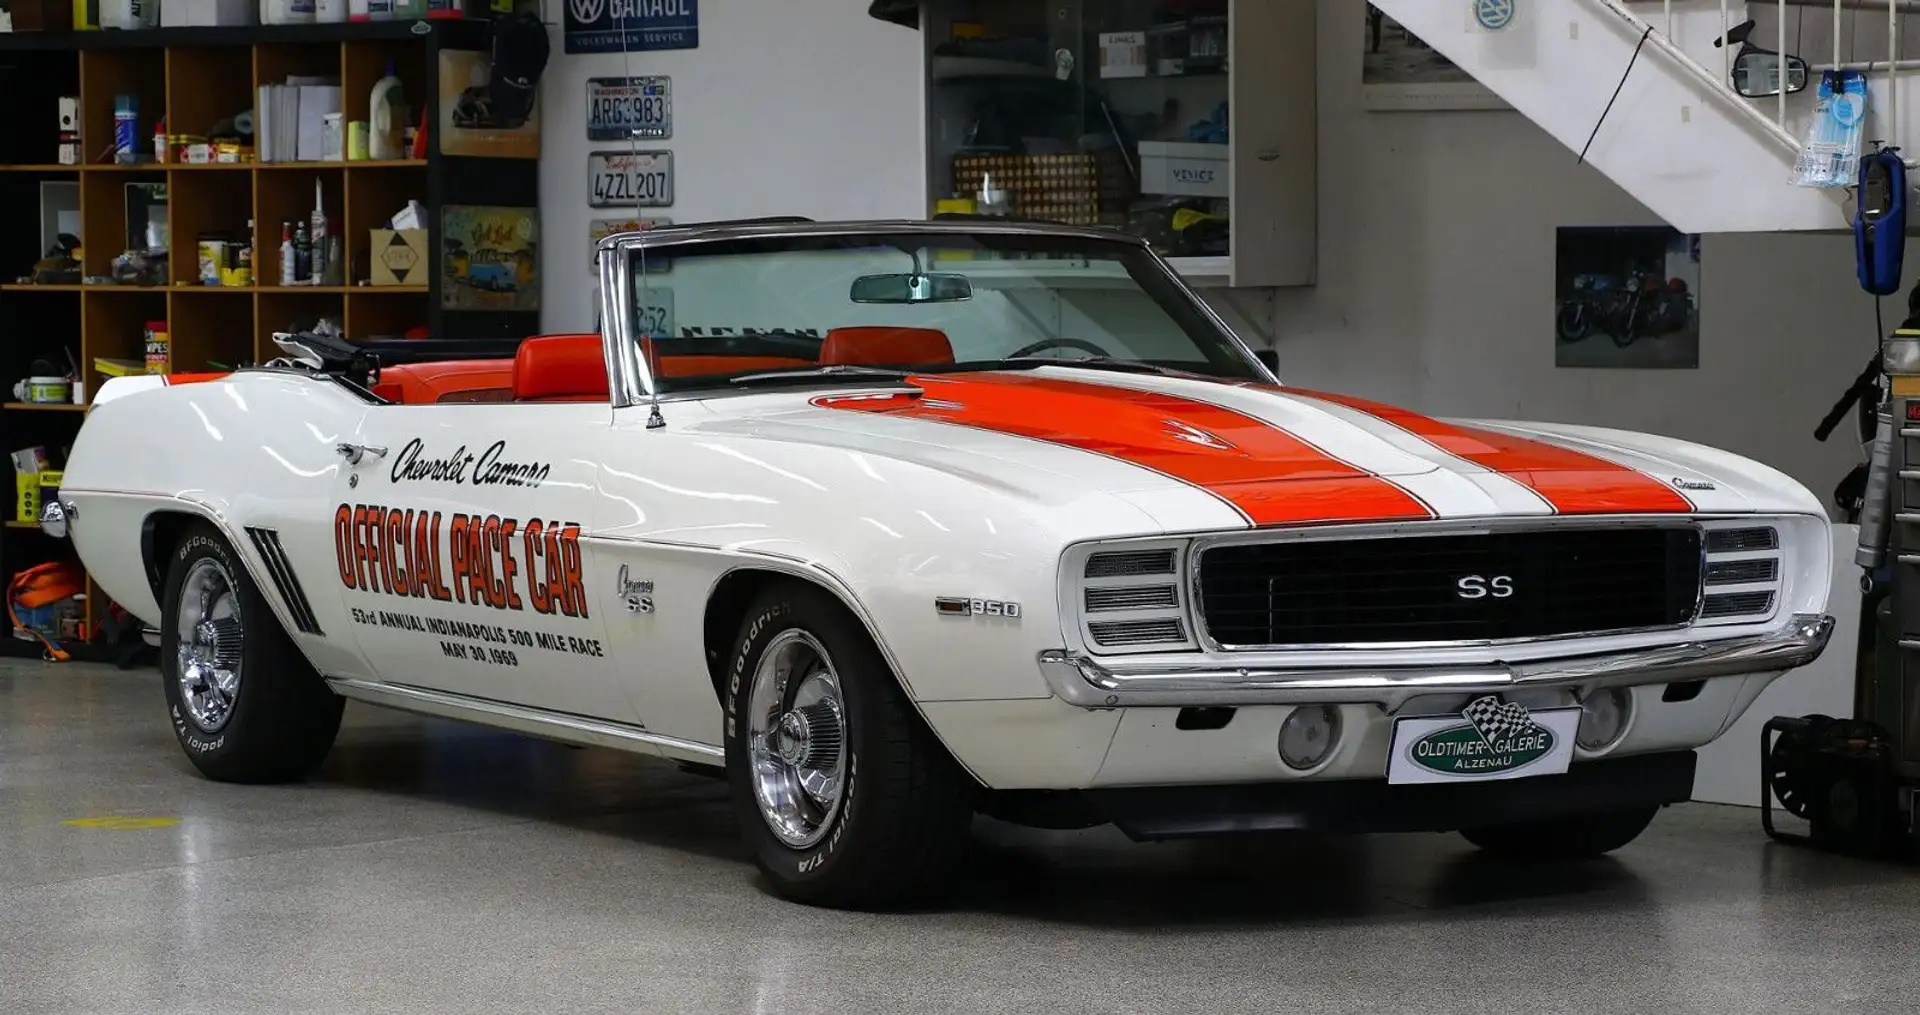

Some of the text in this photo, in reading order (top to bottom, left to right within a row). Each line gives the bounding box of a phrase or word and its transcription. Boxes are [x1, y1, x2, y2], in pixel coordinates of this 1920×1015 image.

[594, 172, 666, 199] 4ZZL207
[391, 438, 550, 488] Chevrolet Camaro
[335, 503, 589, 619] OFFICIAL PACE CAR
[1458, 575, 1513, 598] SS
[627, 597, 655, 614] SS
[970, 598, 1022, 618] 350
[351, 608, 604, 657] 53rd ANNUAL INDIANAPOLIS 500 MILE RACE
[440, 641, 467, 658] MAY
[1496, 732, 1547, 753] GALERIE
[1454, 756, 1512, 769] ALZENAU
